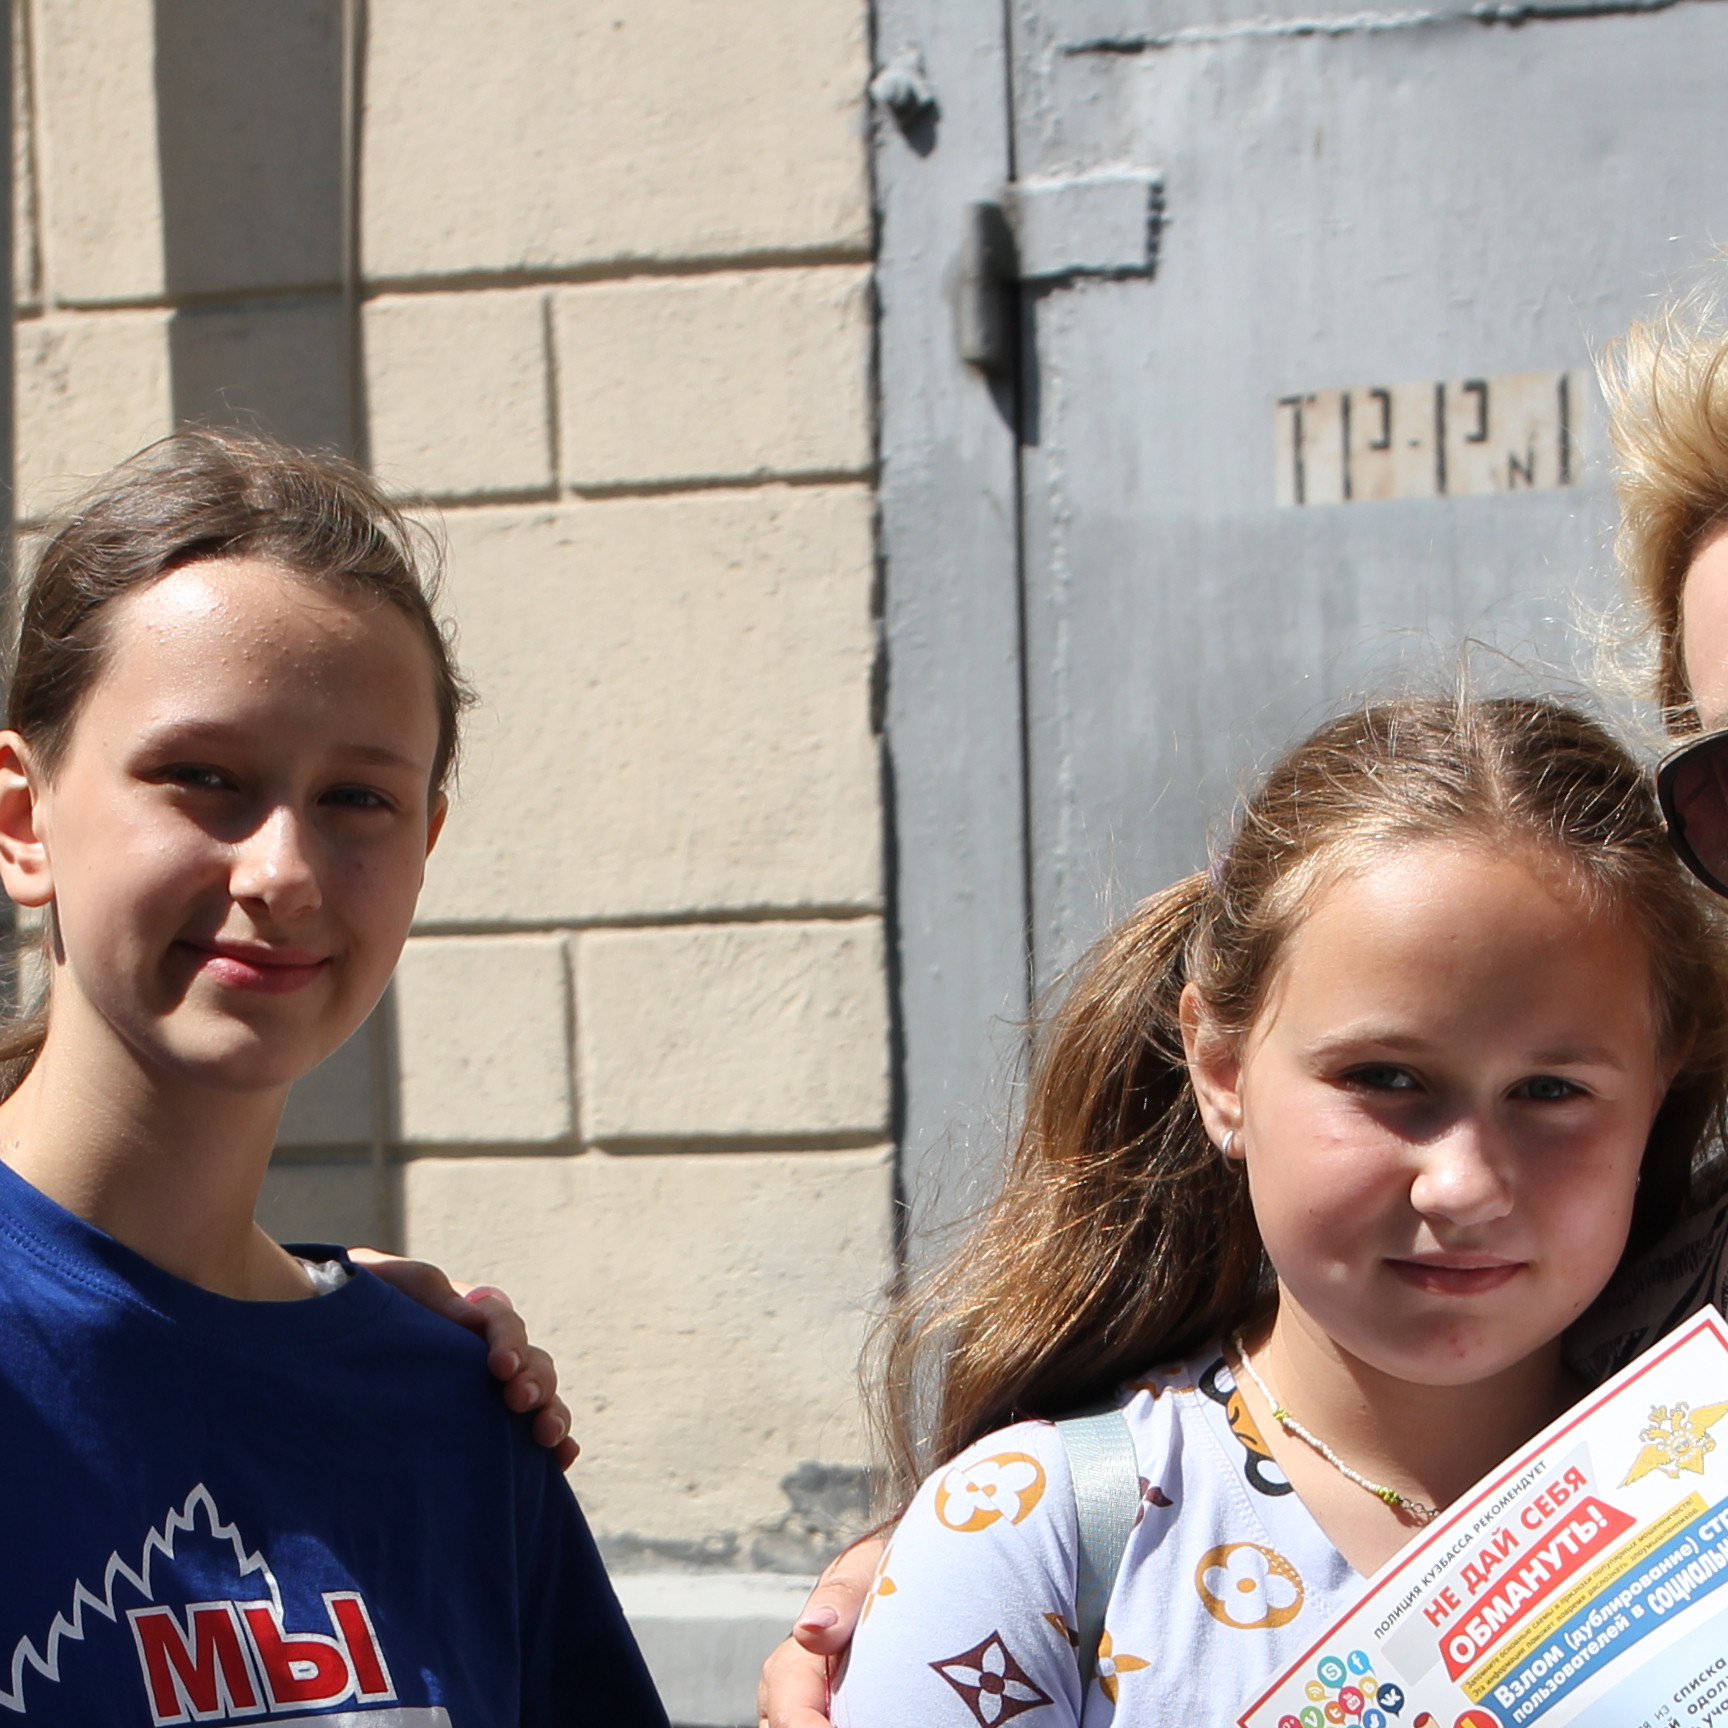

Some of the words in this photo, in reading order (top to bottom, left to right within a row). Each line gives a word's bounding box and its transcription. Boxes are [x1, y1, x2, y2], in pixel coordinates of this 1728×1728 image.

[1373, 1585, 1423, 1640] ПОЛИЦИЯ
[1421, 1533, 1474, 1587] КУЗБАССА
[1472, 1460, 1546, 1534] РЕКОМЕНДУЕТ
[1423, 1586, 1462, 1627] НЕ
[1460, 1528, 1520, 1595] ДАЙ
[1520, 1466, 1588, 1530] СЕБЯ
[1449, 1504, 1608, 1664] ОБМАНУТЬ!
[1493, 1645, 1565, 1709] Взлом
[1564, 1536, 1700, 1651] (дублирование)
[127, 1590, 398, 1727] МЫ
[1512, 1613, 1631, 1724] пользователей
[1630, 1604, 1645, 1619] в
[1654, 1704, 1671, 1721] из
[1673, 1657, 1727, 1703] списка
